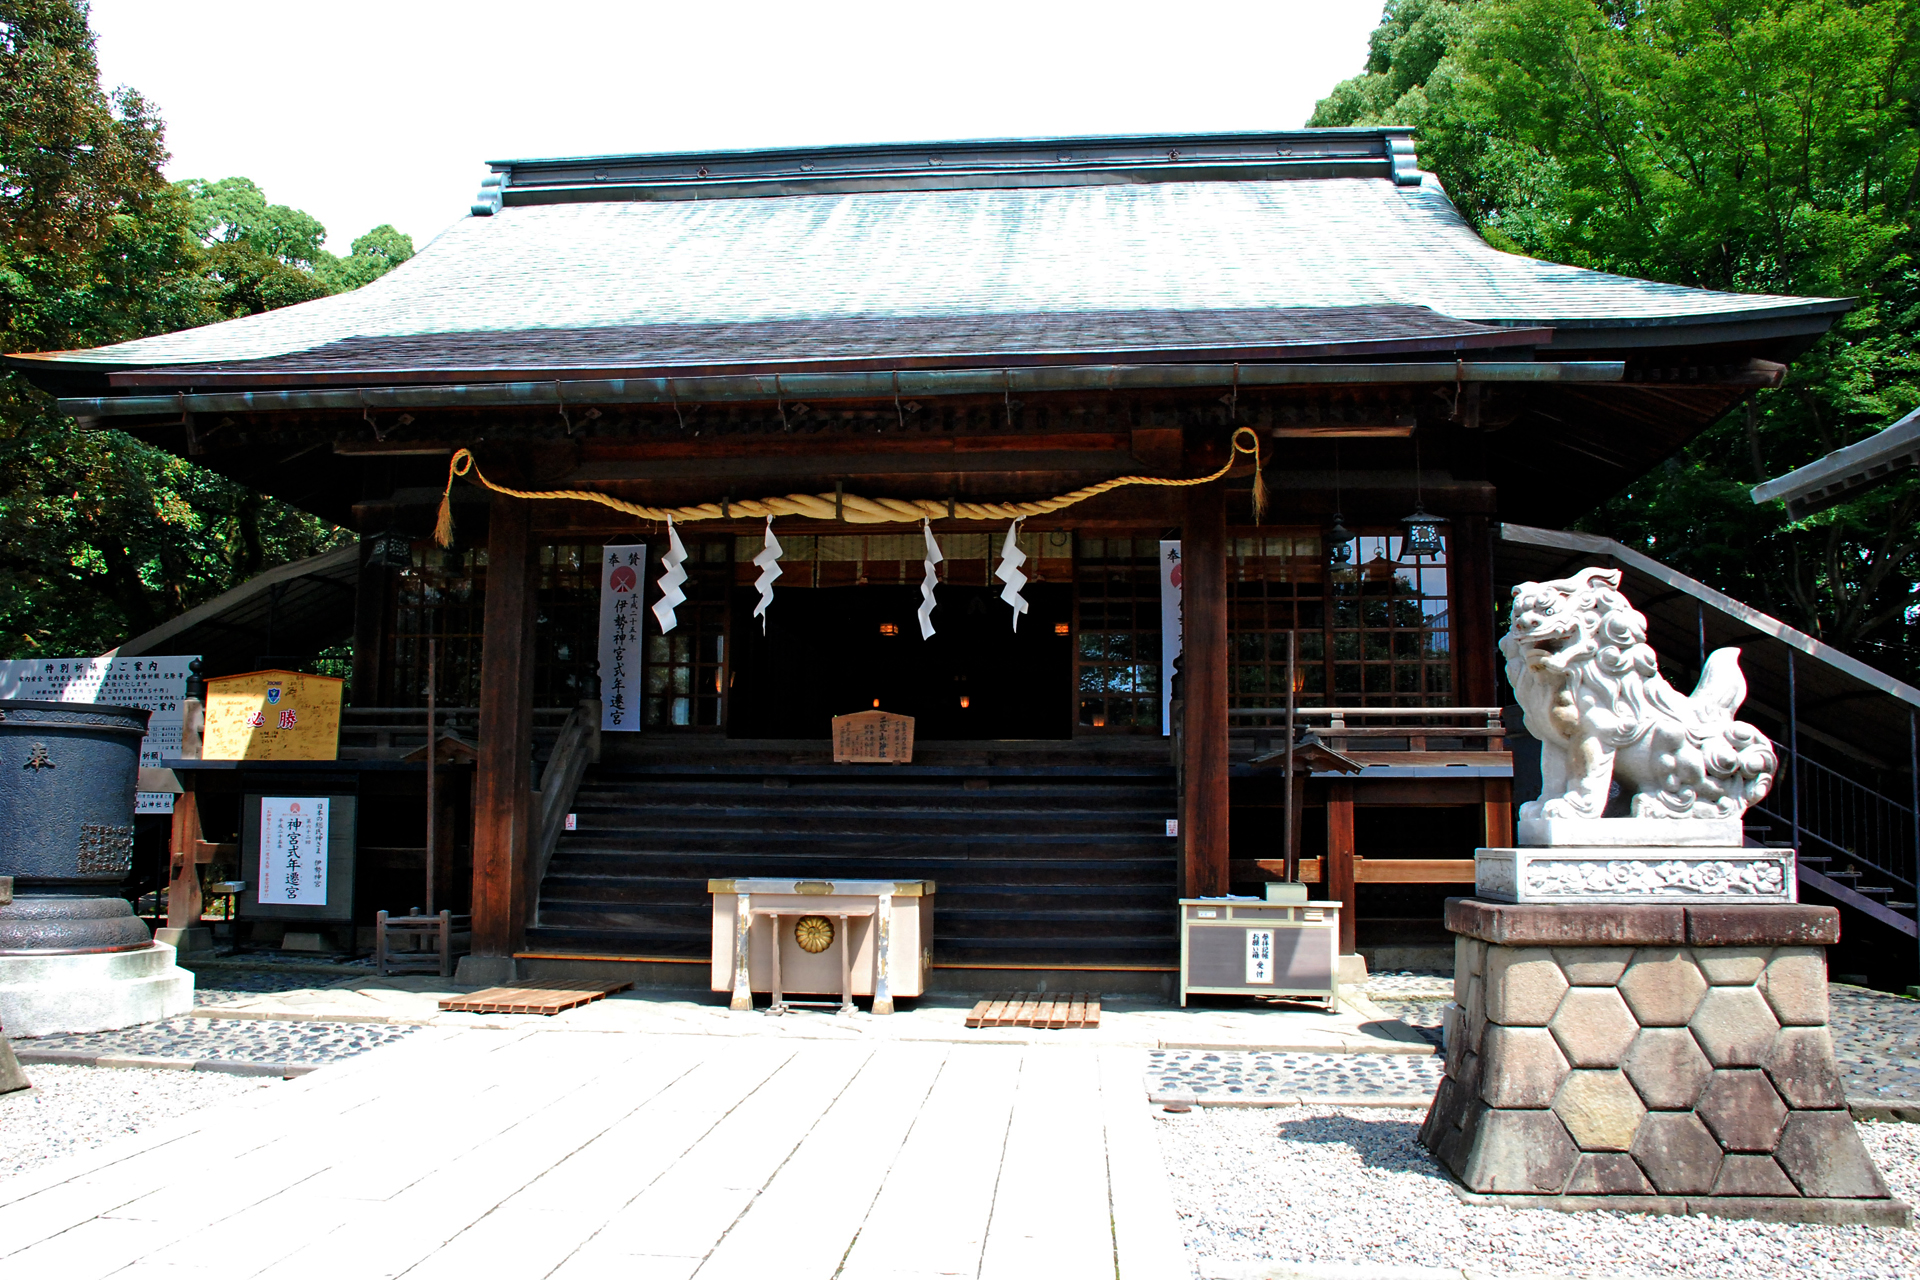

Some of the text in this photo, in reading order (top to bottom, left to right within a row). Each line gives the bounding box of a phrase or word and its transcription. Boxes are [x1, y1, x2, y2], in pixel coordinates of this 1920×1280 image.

[608, 552, 640, 567] 奉賛
[628, 593, 639, 643] 平成二十五年
[610, 599, 629, 725] 伊勢神宮式年遷宮
[247, 708, 297, 730] 必勝
[23, 742, 56, 772] 奉
[285, 817, 302, 900] 神宮式年遷宮
